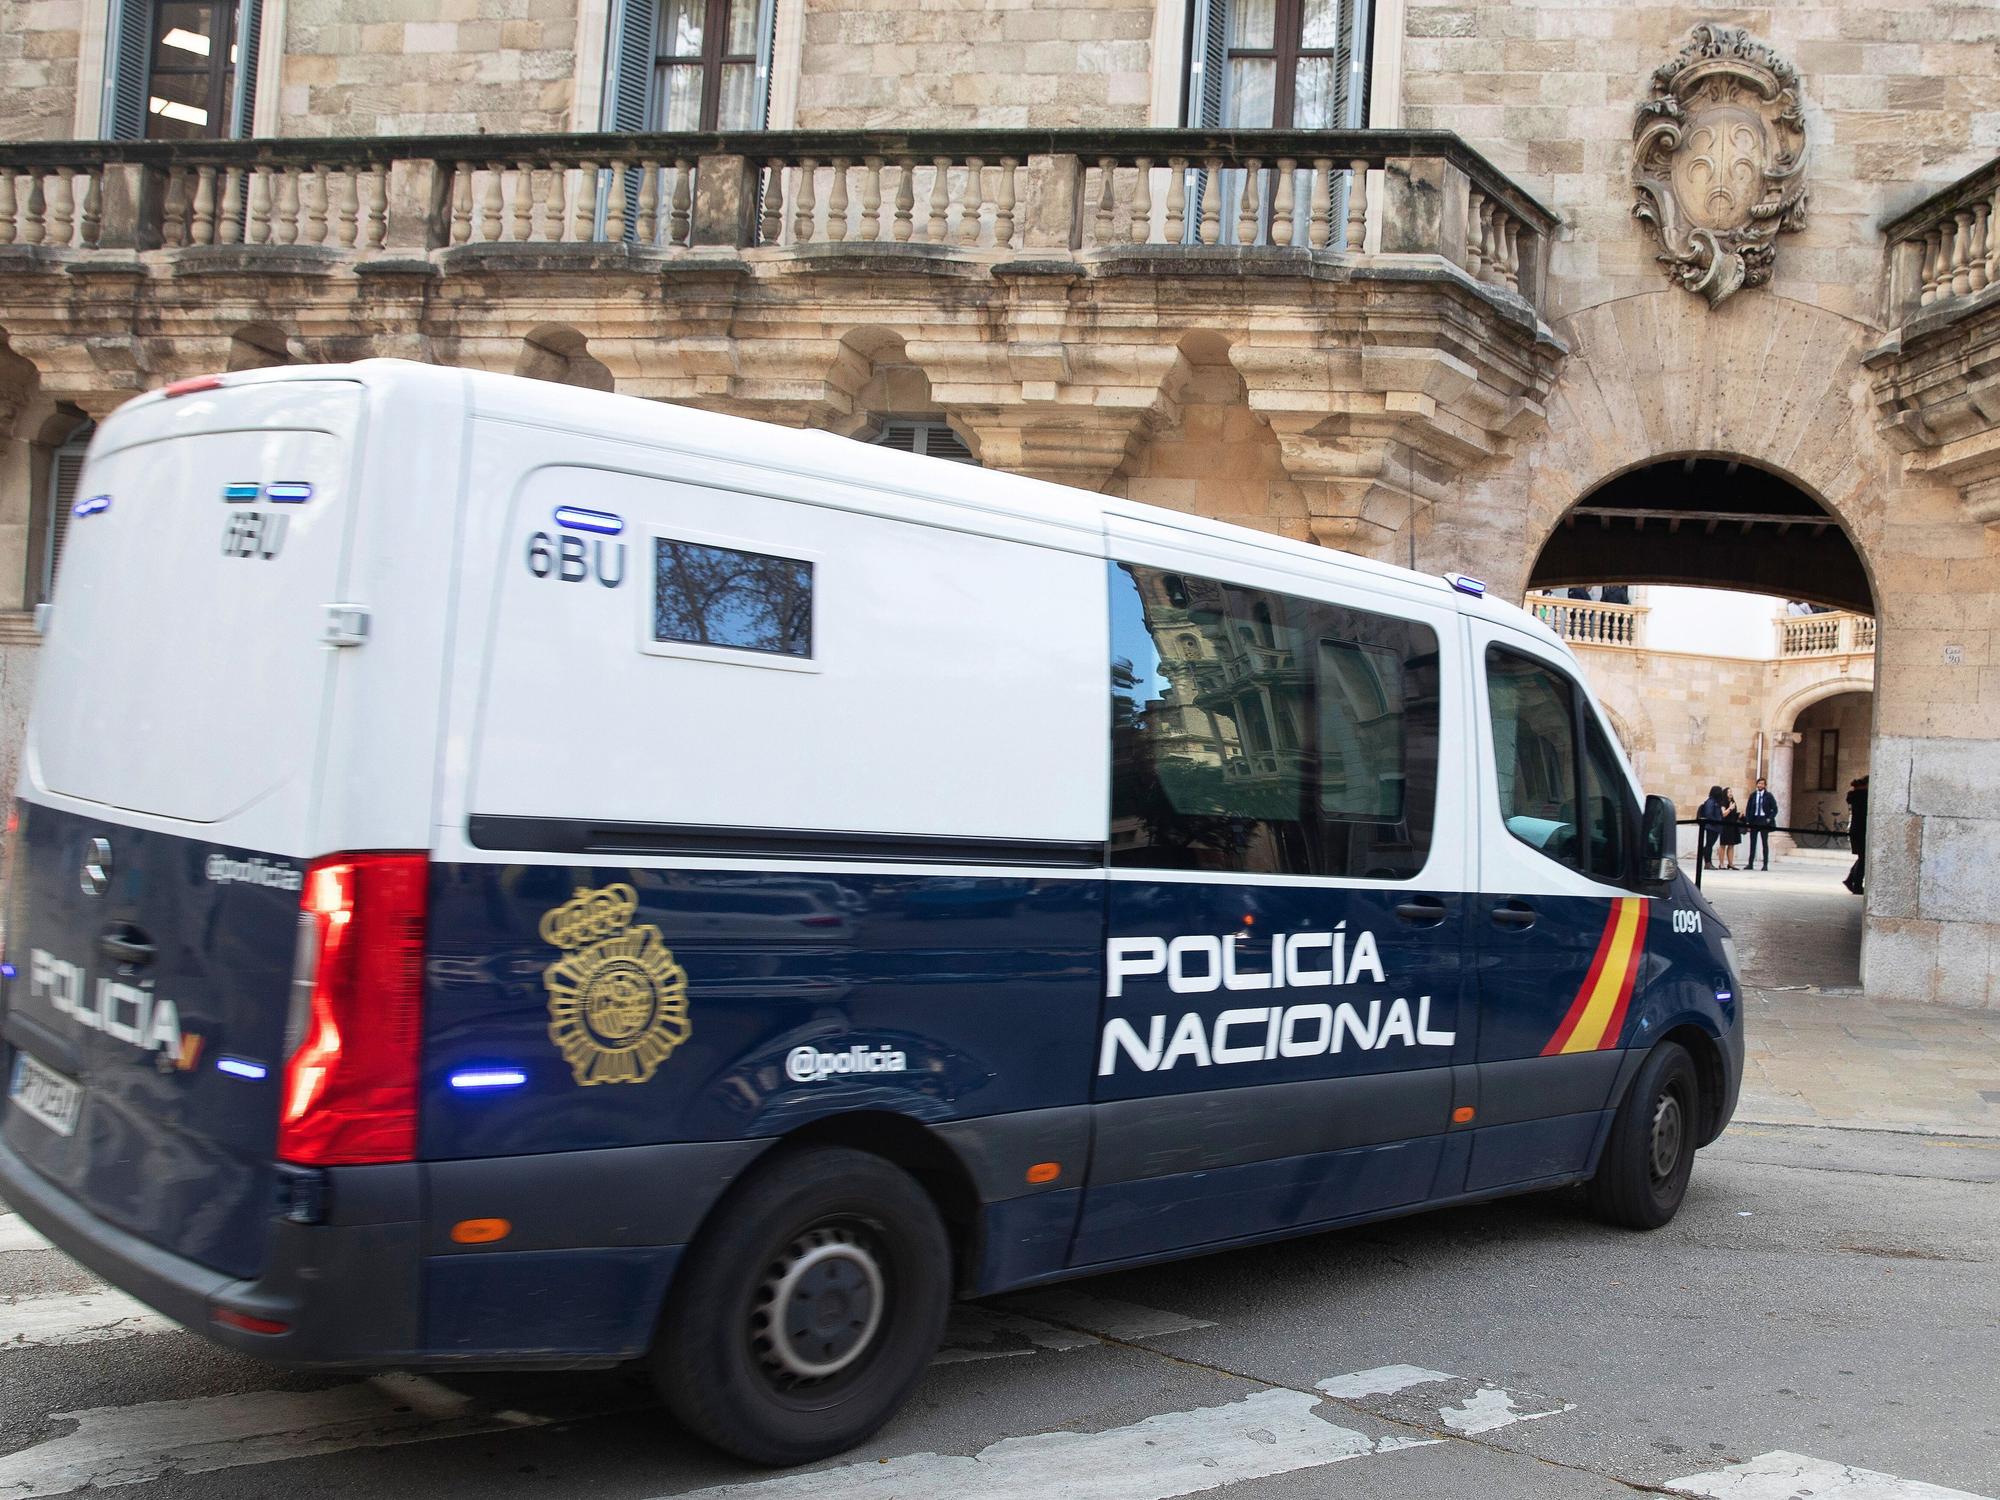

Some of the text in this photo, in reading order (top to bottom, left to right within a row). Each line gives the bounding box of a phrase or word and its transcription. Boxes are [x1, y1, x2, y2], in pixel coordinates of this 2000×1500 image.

[222, 511, 290, 560] 6BU
[527, 531, 626, 589] 6BU
[205, 853, 304, 891] @policia
[1105, 920, 1387, 997] POLICÍA
[1098, 995, 1456, 1076] NACIONAL
[785, 1045, 907, 1082] @policia
